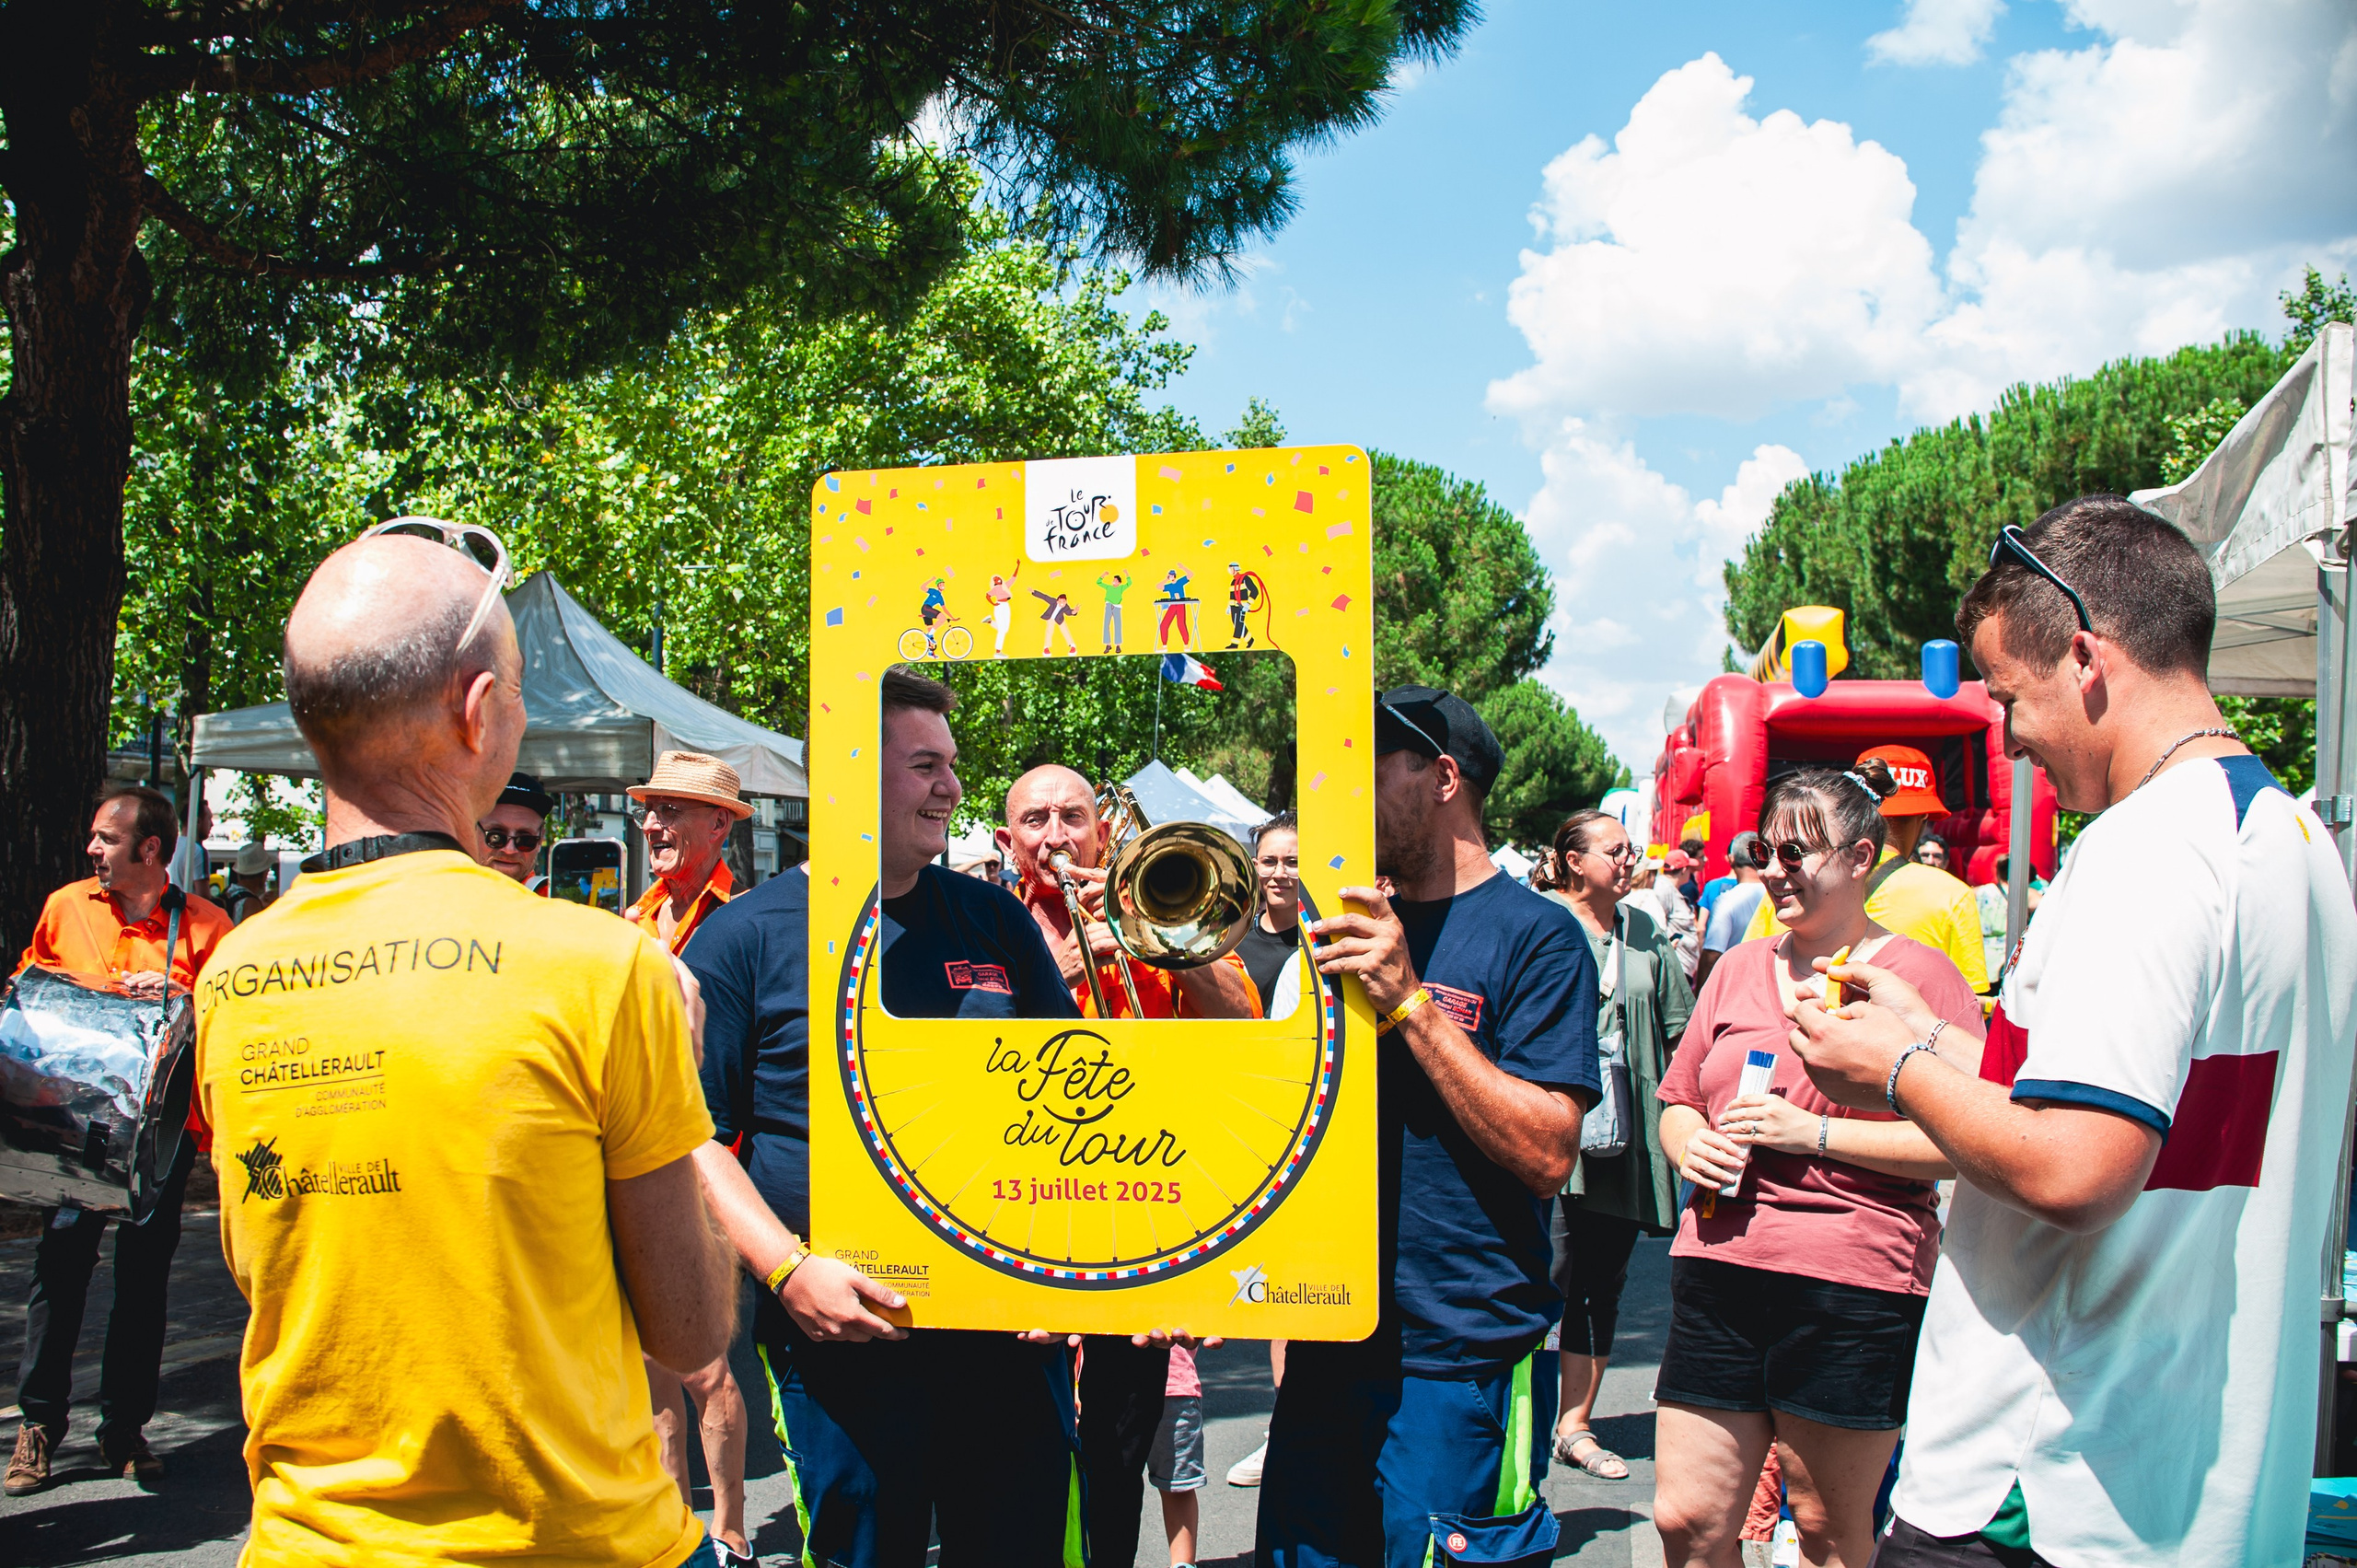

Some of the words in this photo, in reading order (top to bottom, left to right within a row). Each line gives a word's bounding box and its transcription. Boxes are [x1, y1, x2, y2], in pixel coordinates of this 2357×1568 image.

[1442, 996, 1468, 1008] GARAGE
[241, 1038, 309, 1062] GRAND
[240, 1051, 386, 1086] CHÂTELLERAULT
[986, 1037, 1030, 1074] la
[1017, 1028, 1136, 1102] Fête
[316, 1083, 385, 1102] COMMUNAUTÉ
[1004, 1109, 1061, 1146] du
[261, 1158, 402, 1200] Châtellerault
[338, 1163, 362, 1174] VILLE
[367, 1161, 381, 1173] DE
[993, 1179, 1022, 1202] 13
[1028, 1178, 1109, 1205] juillet
[1116, 1180, 1182, 1204] 2025
[834, 1249, 879, 1261] GRAND
[849, 1260, 930, 1276] ÂTELLERAULT
[1248, 1281, 1352, 1306] Châtellerault
